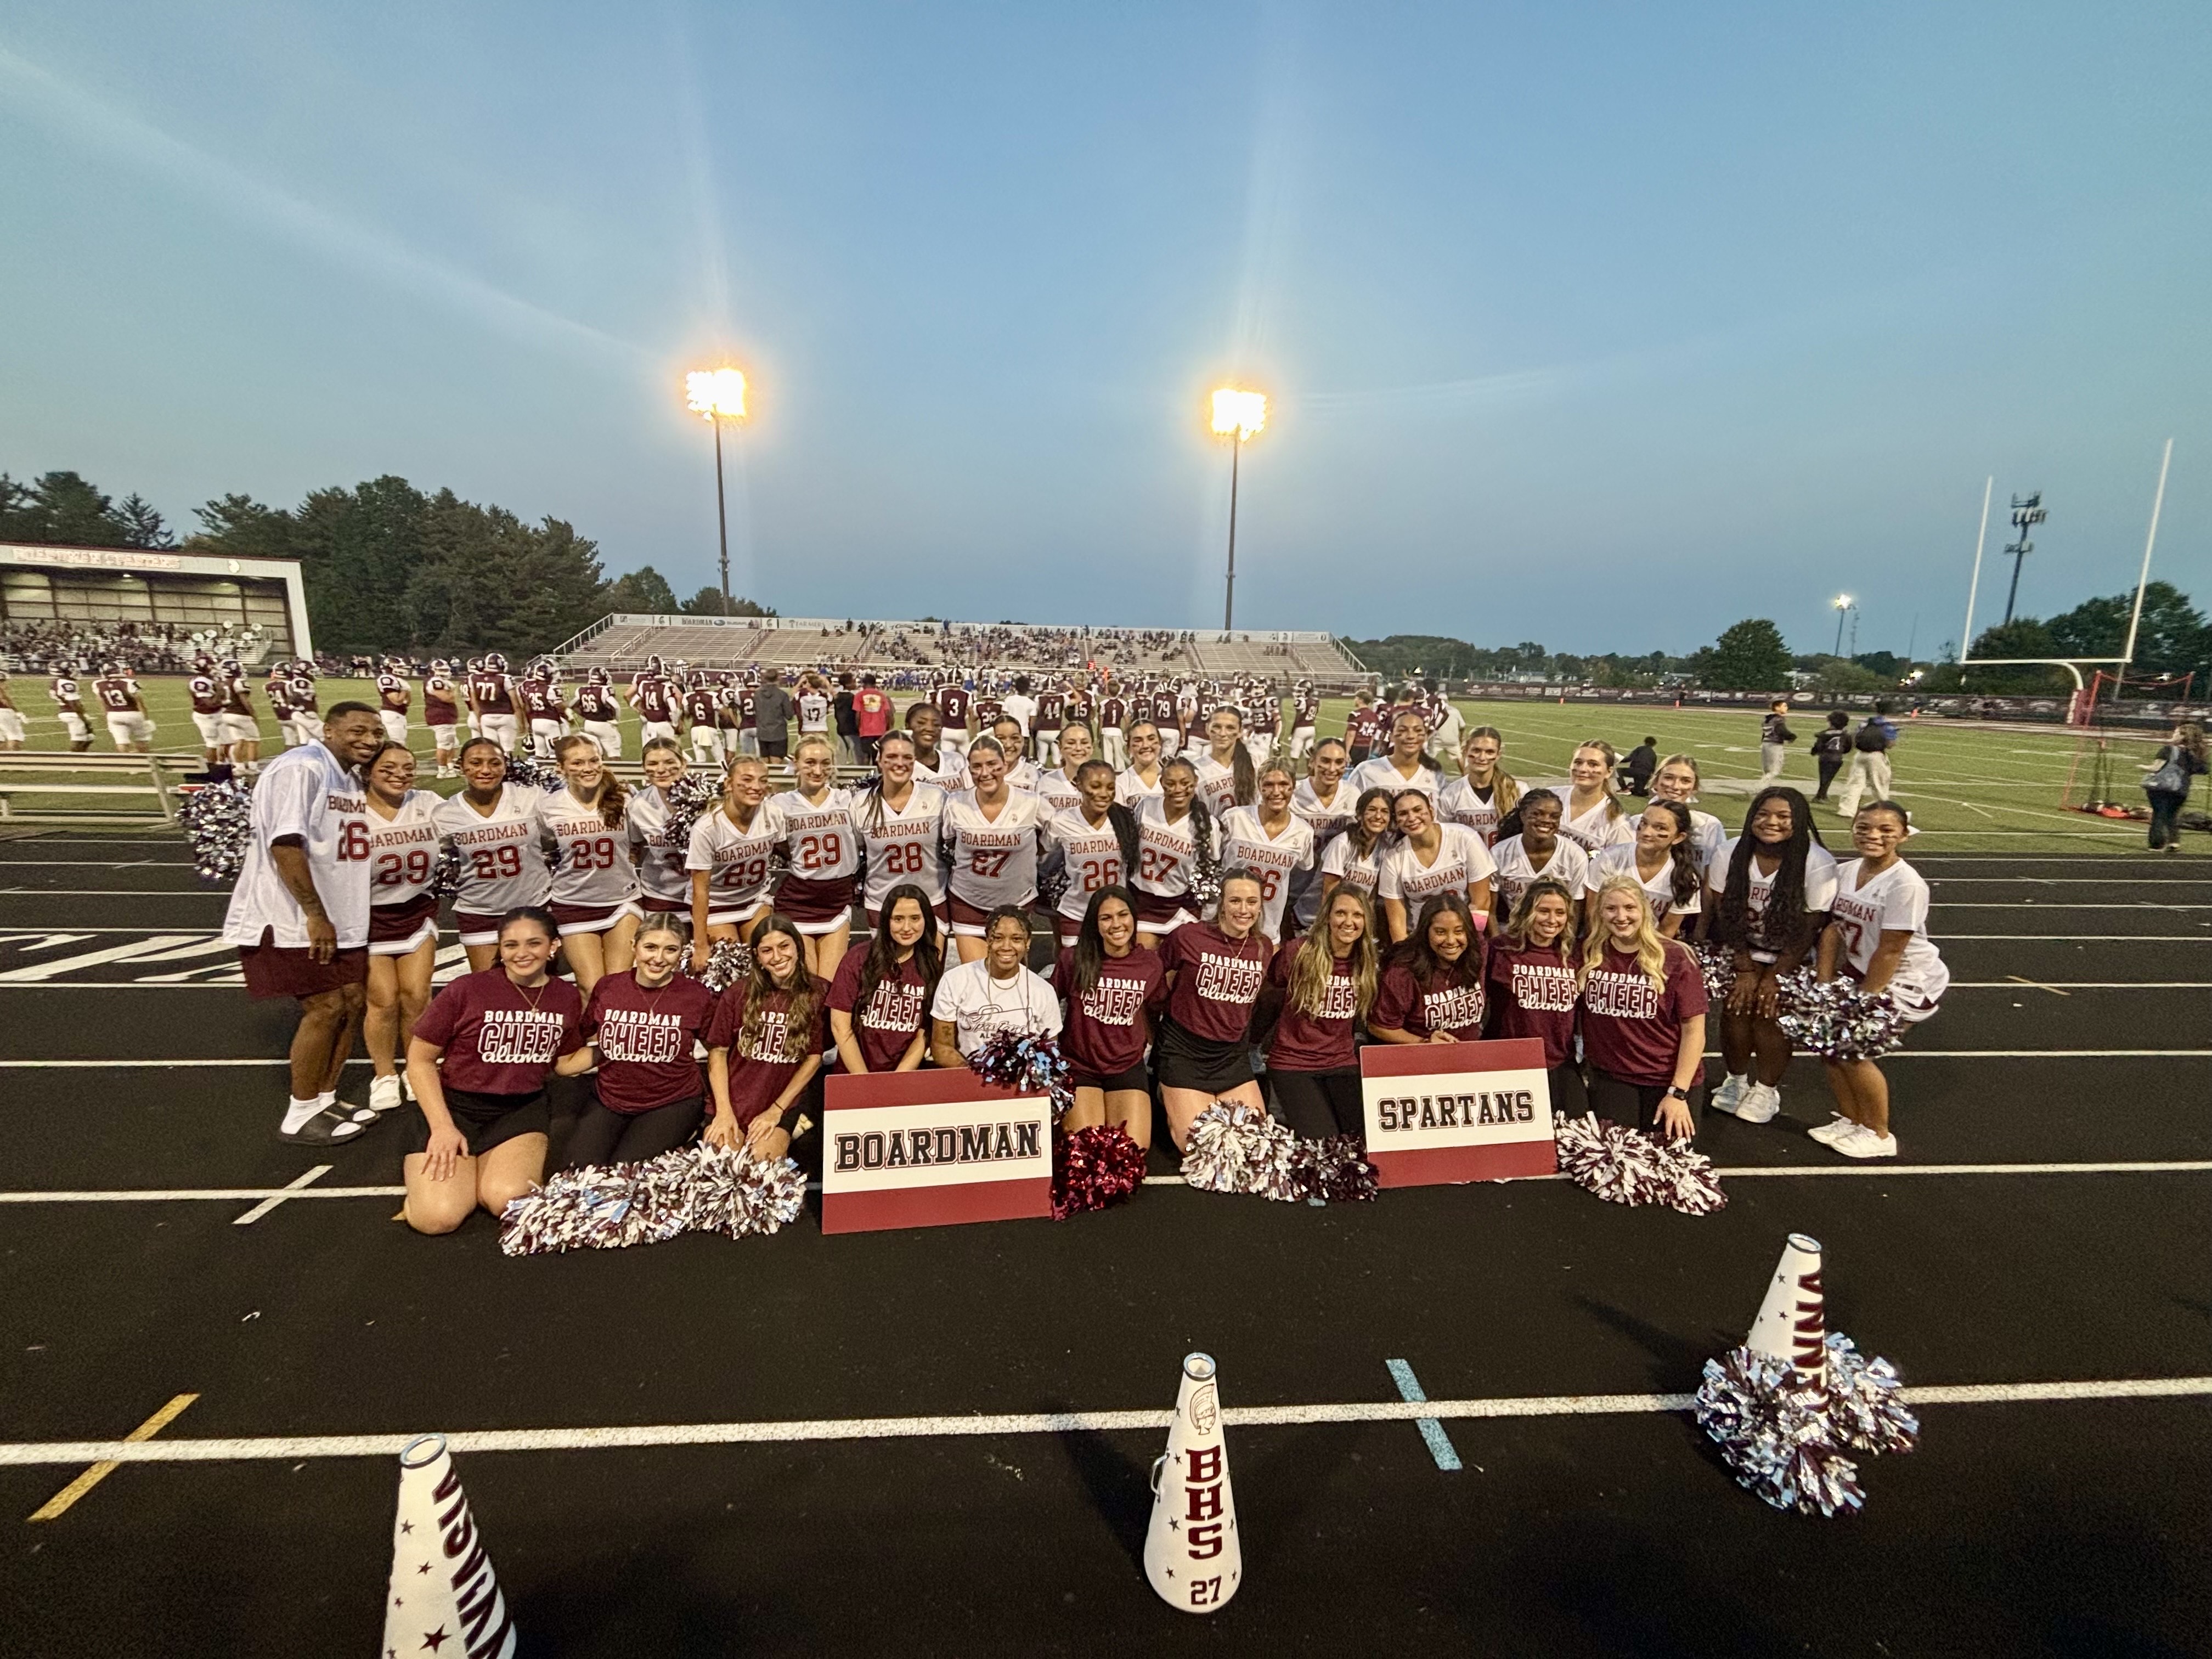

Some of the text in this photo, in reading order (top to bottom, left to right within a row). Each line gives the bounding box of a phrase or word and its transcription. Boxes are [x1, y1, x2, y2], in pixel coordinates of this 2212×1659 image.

[476, 682, 496, 701] 77
[529, 692, 545, 711] 35
[582, 694, 597, 713] 66
[645, 691, 659, 710] 14
[695, 703, 706, 720] 6
[808, 708, 821, 721] 17
[949, 698, 959, 716] 3
[1044, 702, 1060, 719] 44
[1156, 702, 1170, 718] 79
[454, 823, 528, 846] BOARDMAN
[788, 812, 848, 833] BOARDMAN
[714, 839, 774, 861] BOARDMAN
[799, 832, 842, 870] 29
[961, 832, 1021, 847] BOARDMAN
[470, 845, 522, 880] 29
[569, 837, 615, 870] 29
[883, 841, 923, 873] 28
[971, 850, 1011, 879] 27
[1140, 847, 1180, 884] 27
[1237, 845, 1294, 868] BOARDMAN
[375, 849, 430, 886] 29
[723, 859, 767, 887] 29
[1080, 857, 1120, 893] 26
[1404, 867, 1465, 893] BOARDMAN
[1201, 951, 1262, 972] BOARDMAN
[1513, 963, 1575, 978] BOARDMAN
[1195, 962, 1262, 999] CHEER
[1513, 975, 1579, 1006] CHEER
[1425, 990, 1485, 1030] CHEER
[1585, 979, 1658, 1015] CHEER
[484, 1010, 564, 1025] BOARDMAN
[603, 1008, 682, 1026] BOARDMAN
[477, 1023, 563, 1056] CHEER
[599, 1021, 681, 1058] CHEER
[1377, 1090, 1536, 1133] SPARTANS
[834, 1120, 1042, 1173] BOARDMAN
[1185, 1444, 1223, 1560] BHS
[1190, 1575, 1222, 1605] 27
